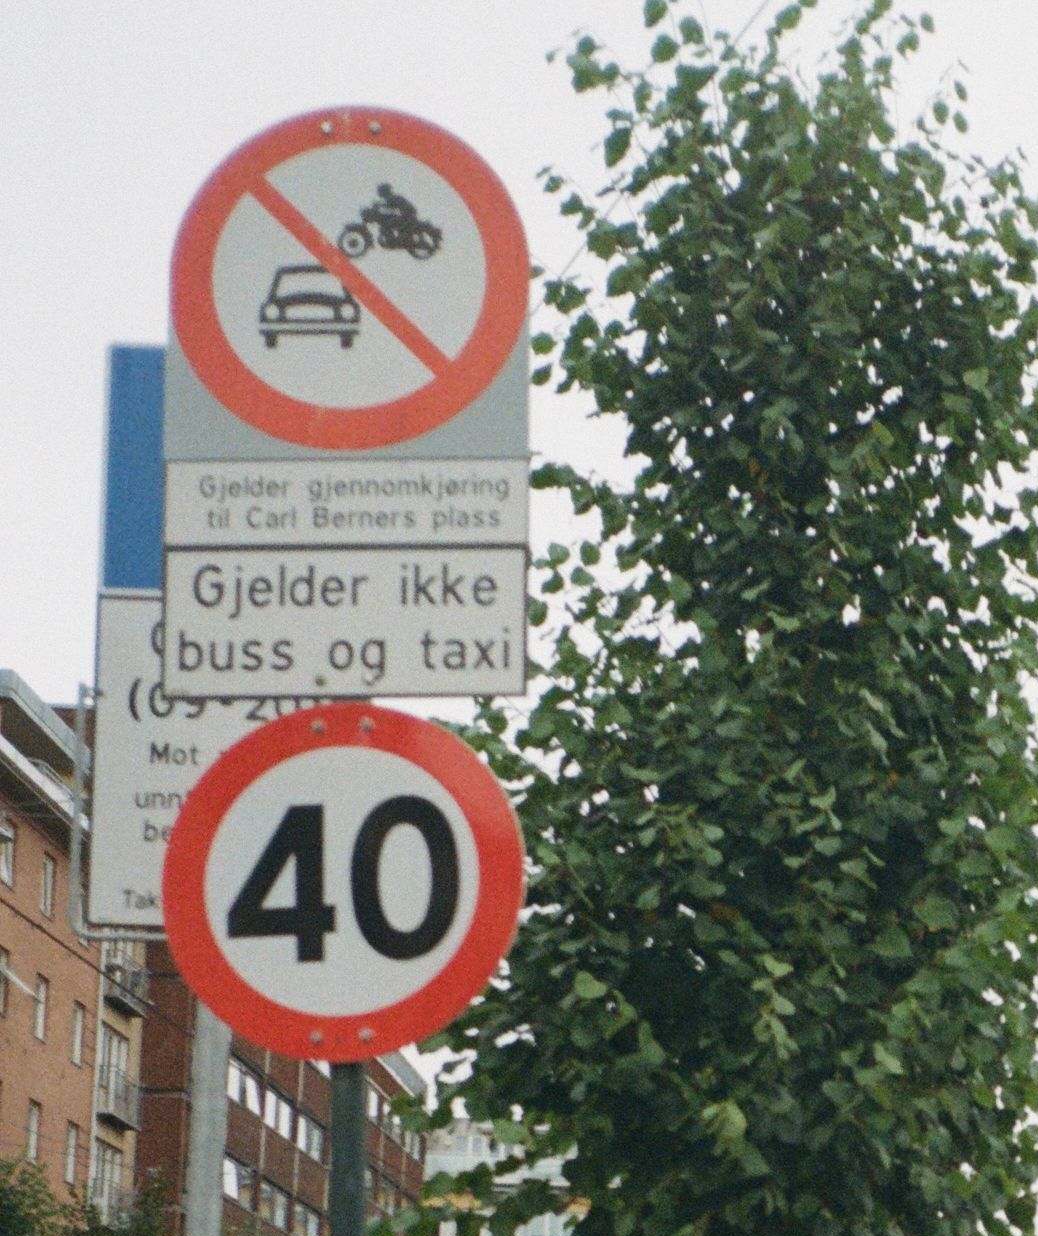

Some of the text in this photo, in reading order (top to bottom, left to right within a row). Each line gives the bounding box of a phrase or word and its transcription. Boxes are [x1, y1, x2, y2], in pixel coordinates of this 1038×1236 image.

[199, 474, 511, 502] Gjelder gjennomkjøring
[207, 506, 501, 533] til Carl Berners plass
[192, 563, 499, 619] Gjelder ikke
[178, 631, 295, 671] buss
[328, 637, 387, 687] og
[420, 629, 512, 671] taxi
[149, 742, 199, 766] Mot
[227, 794, 460, 962] 40
